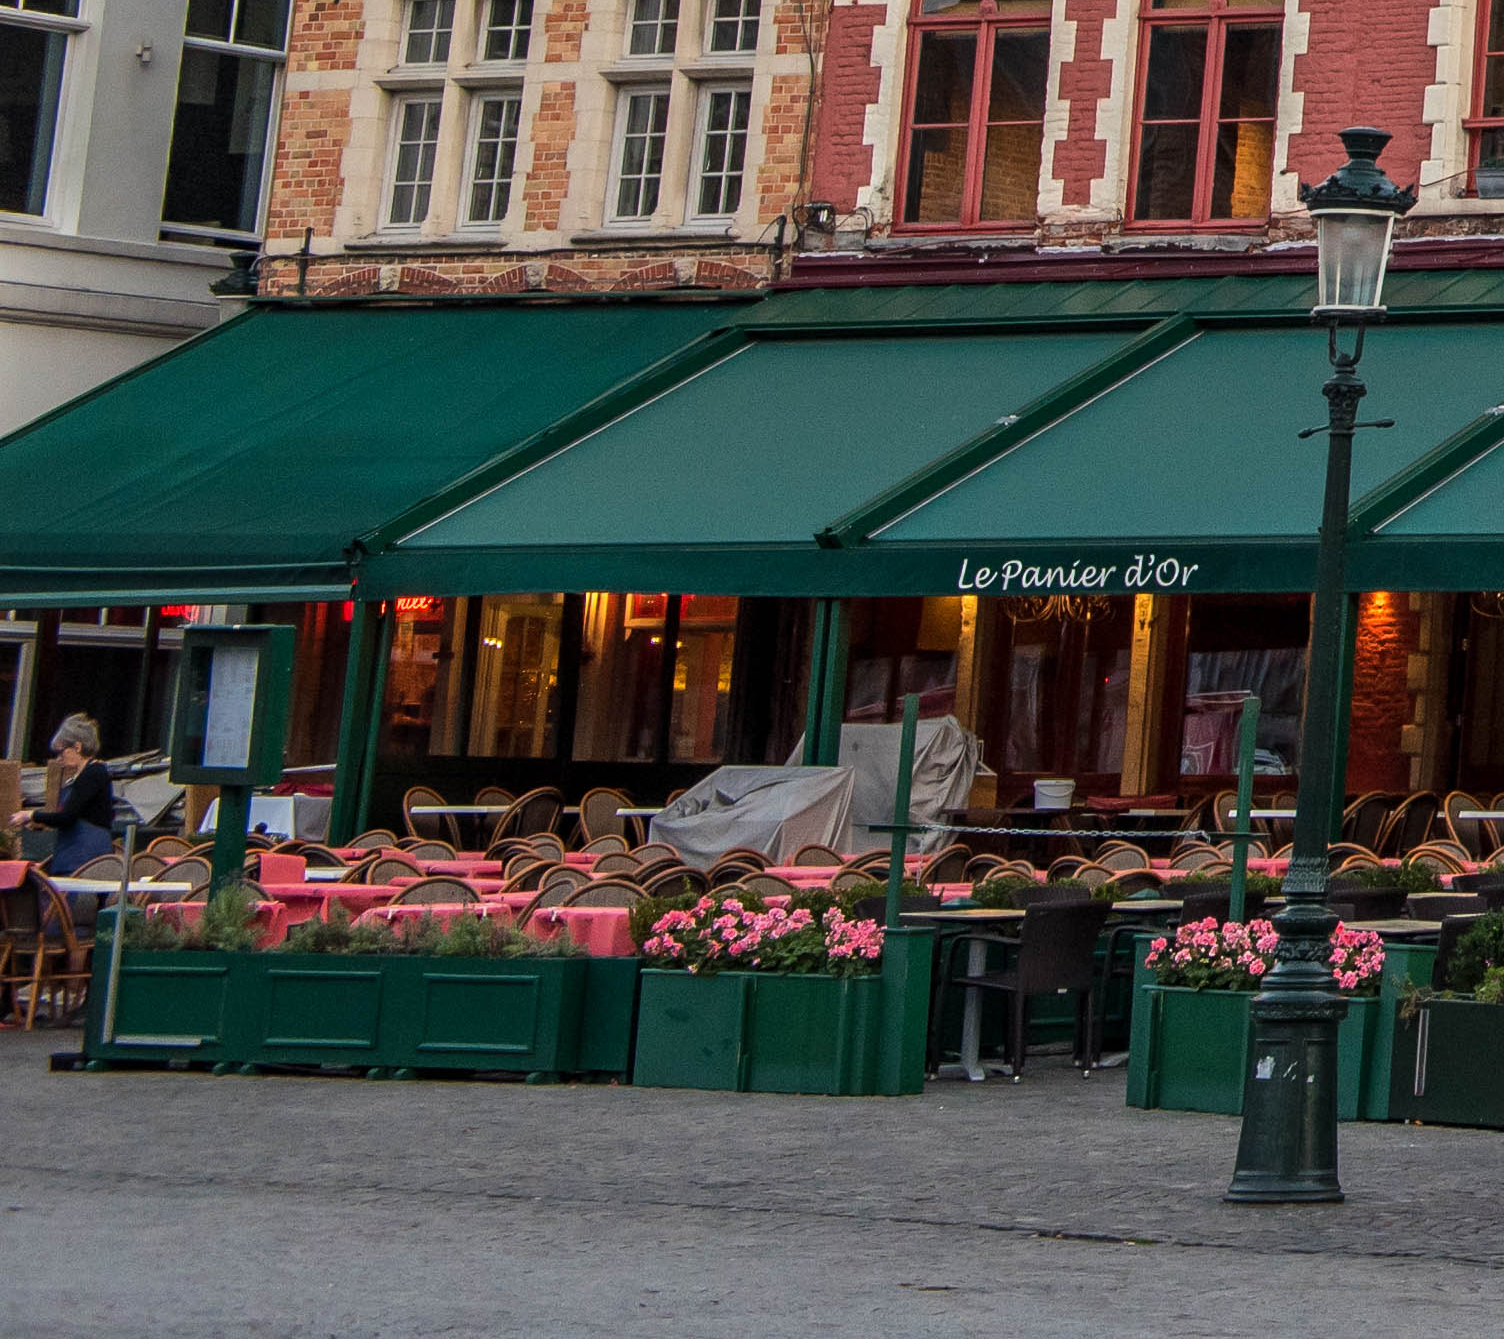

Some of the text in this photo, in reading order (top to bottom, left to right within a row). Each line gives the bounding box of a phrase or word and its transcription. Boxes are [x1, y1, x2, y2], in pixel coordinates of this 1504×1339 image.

[958, 554, 1199, 591] Le Panier d'Or
